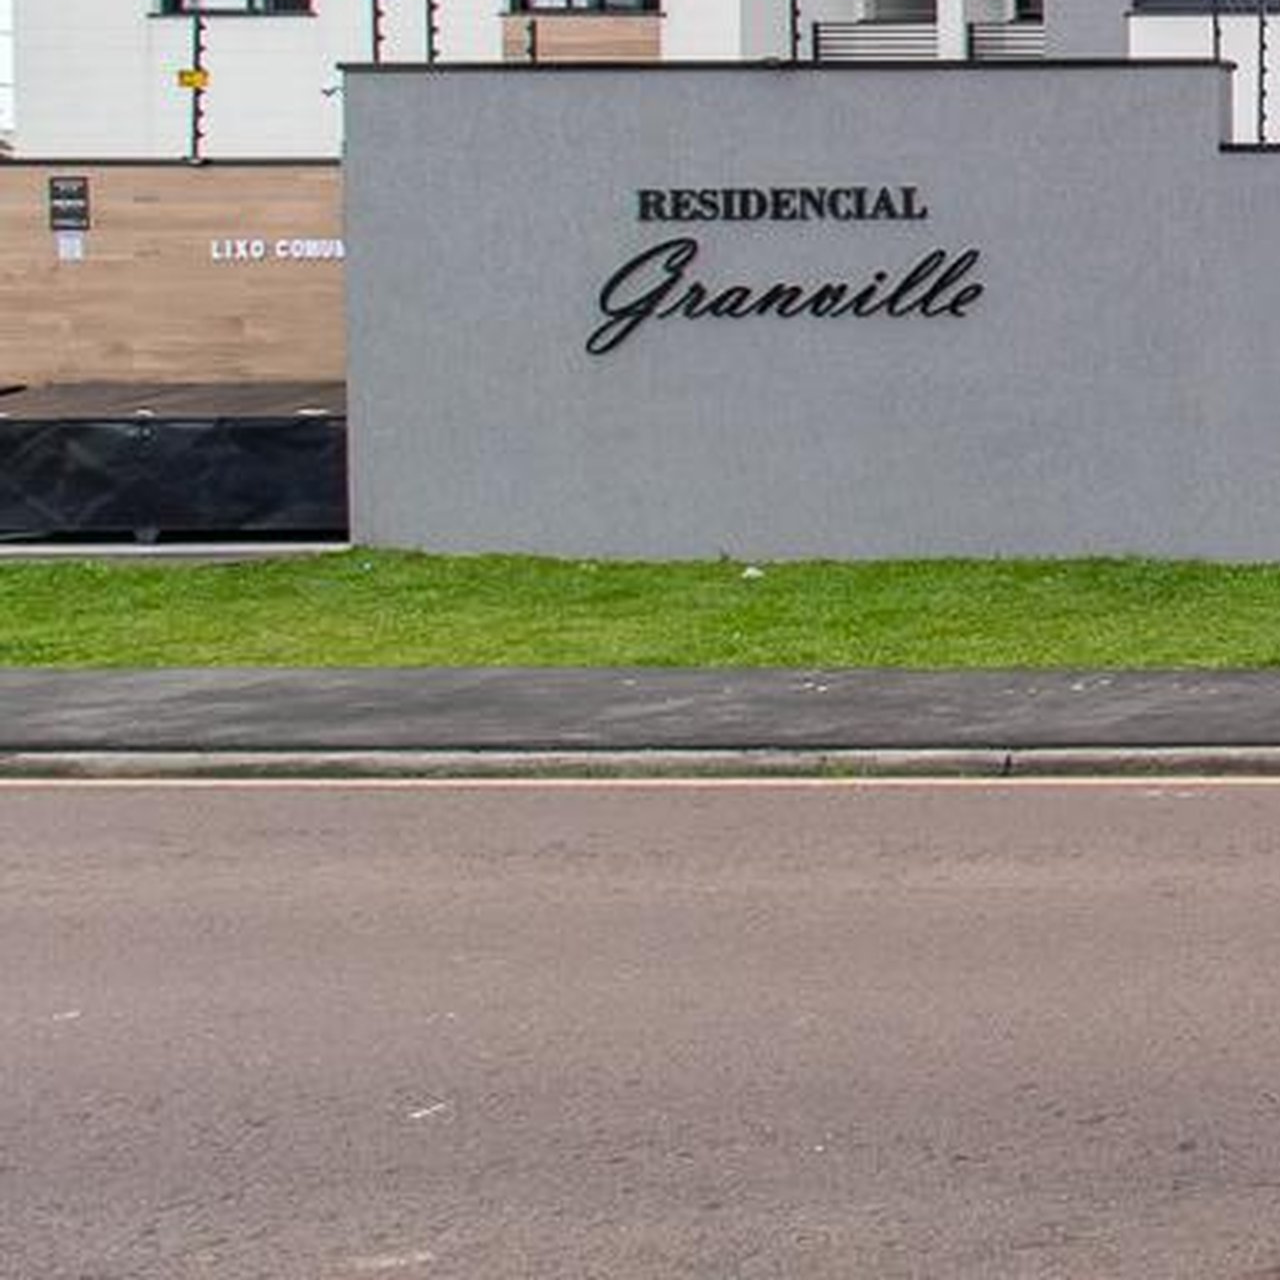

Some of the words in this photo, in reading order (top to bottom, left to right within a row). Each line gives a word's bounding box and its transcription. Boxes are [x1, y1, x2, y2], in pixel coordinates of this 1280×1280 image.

[637, 187, 928, 221] RESIDENCIAL
[210, 239, 265, 259] LIXO
[586, 237, 985, 355] Granville
